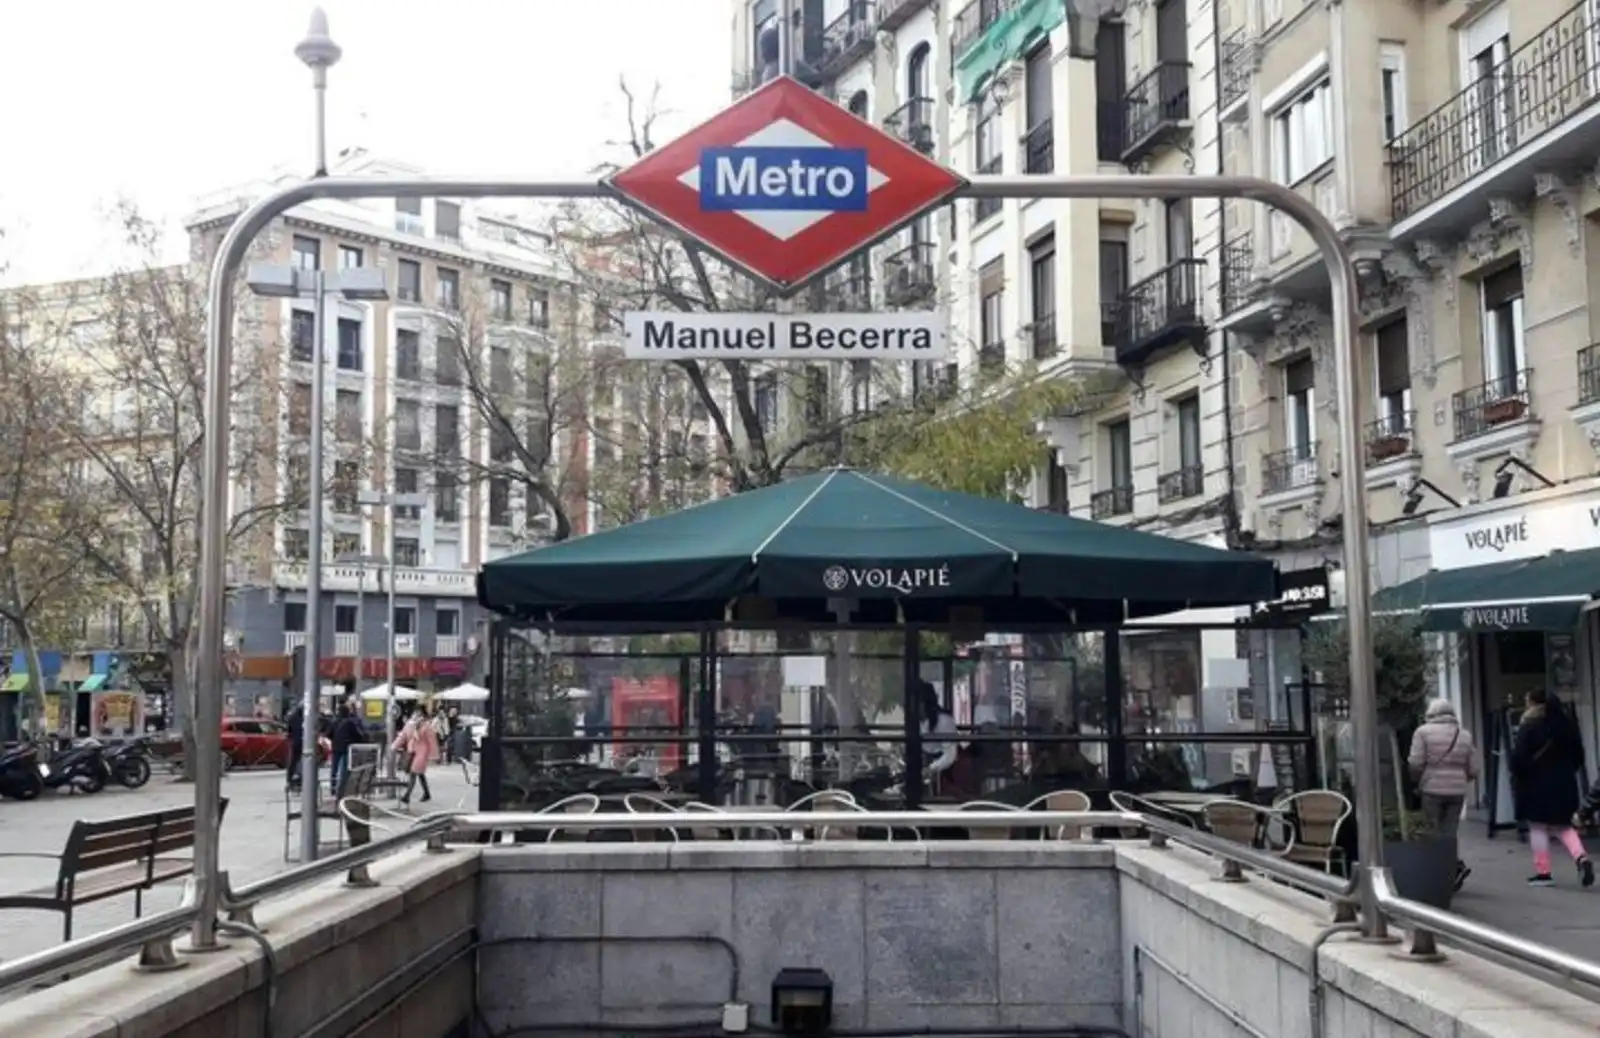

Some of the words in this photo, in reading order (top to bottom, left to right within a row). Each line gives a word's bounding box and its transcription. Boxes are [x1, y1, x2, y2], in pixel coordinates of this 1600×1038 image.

[715, 156, 855, 198] Metro
[643, 320, 775, 350] Manuel
[789, 320, 932, 350] Becerra
[1465, 515, 1528, 552] VOLAPIÉ
[851, 562, 951, 594] VOLAPIÉ
